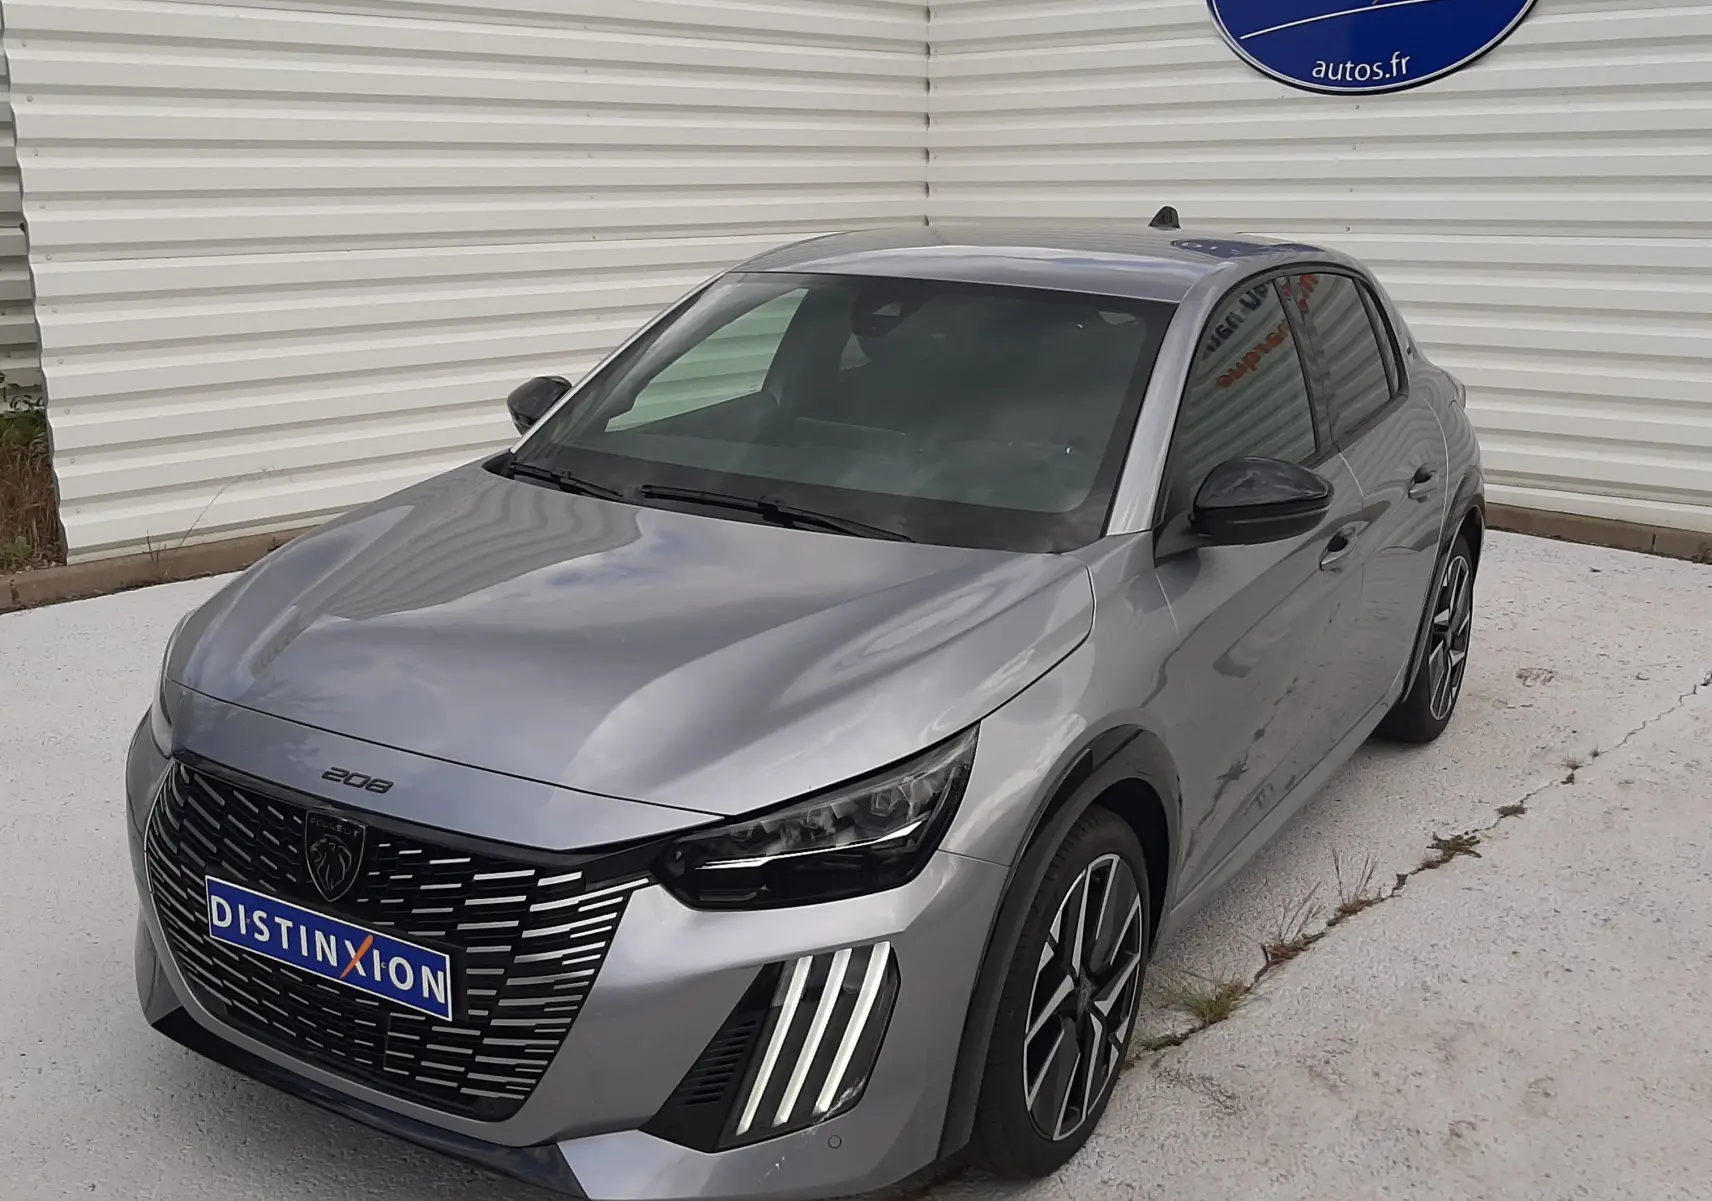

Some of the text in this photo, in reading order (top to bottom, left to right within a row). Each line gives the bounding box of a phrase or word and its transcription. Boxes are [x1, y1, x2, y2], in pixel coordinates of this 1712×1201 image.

[1312, 51, 1411, 82] autos.fr
[321, 766, 394, 794] 208
[210, 894, 446, 1005] DISTINXION
